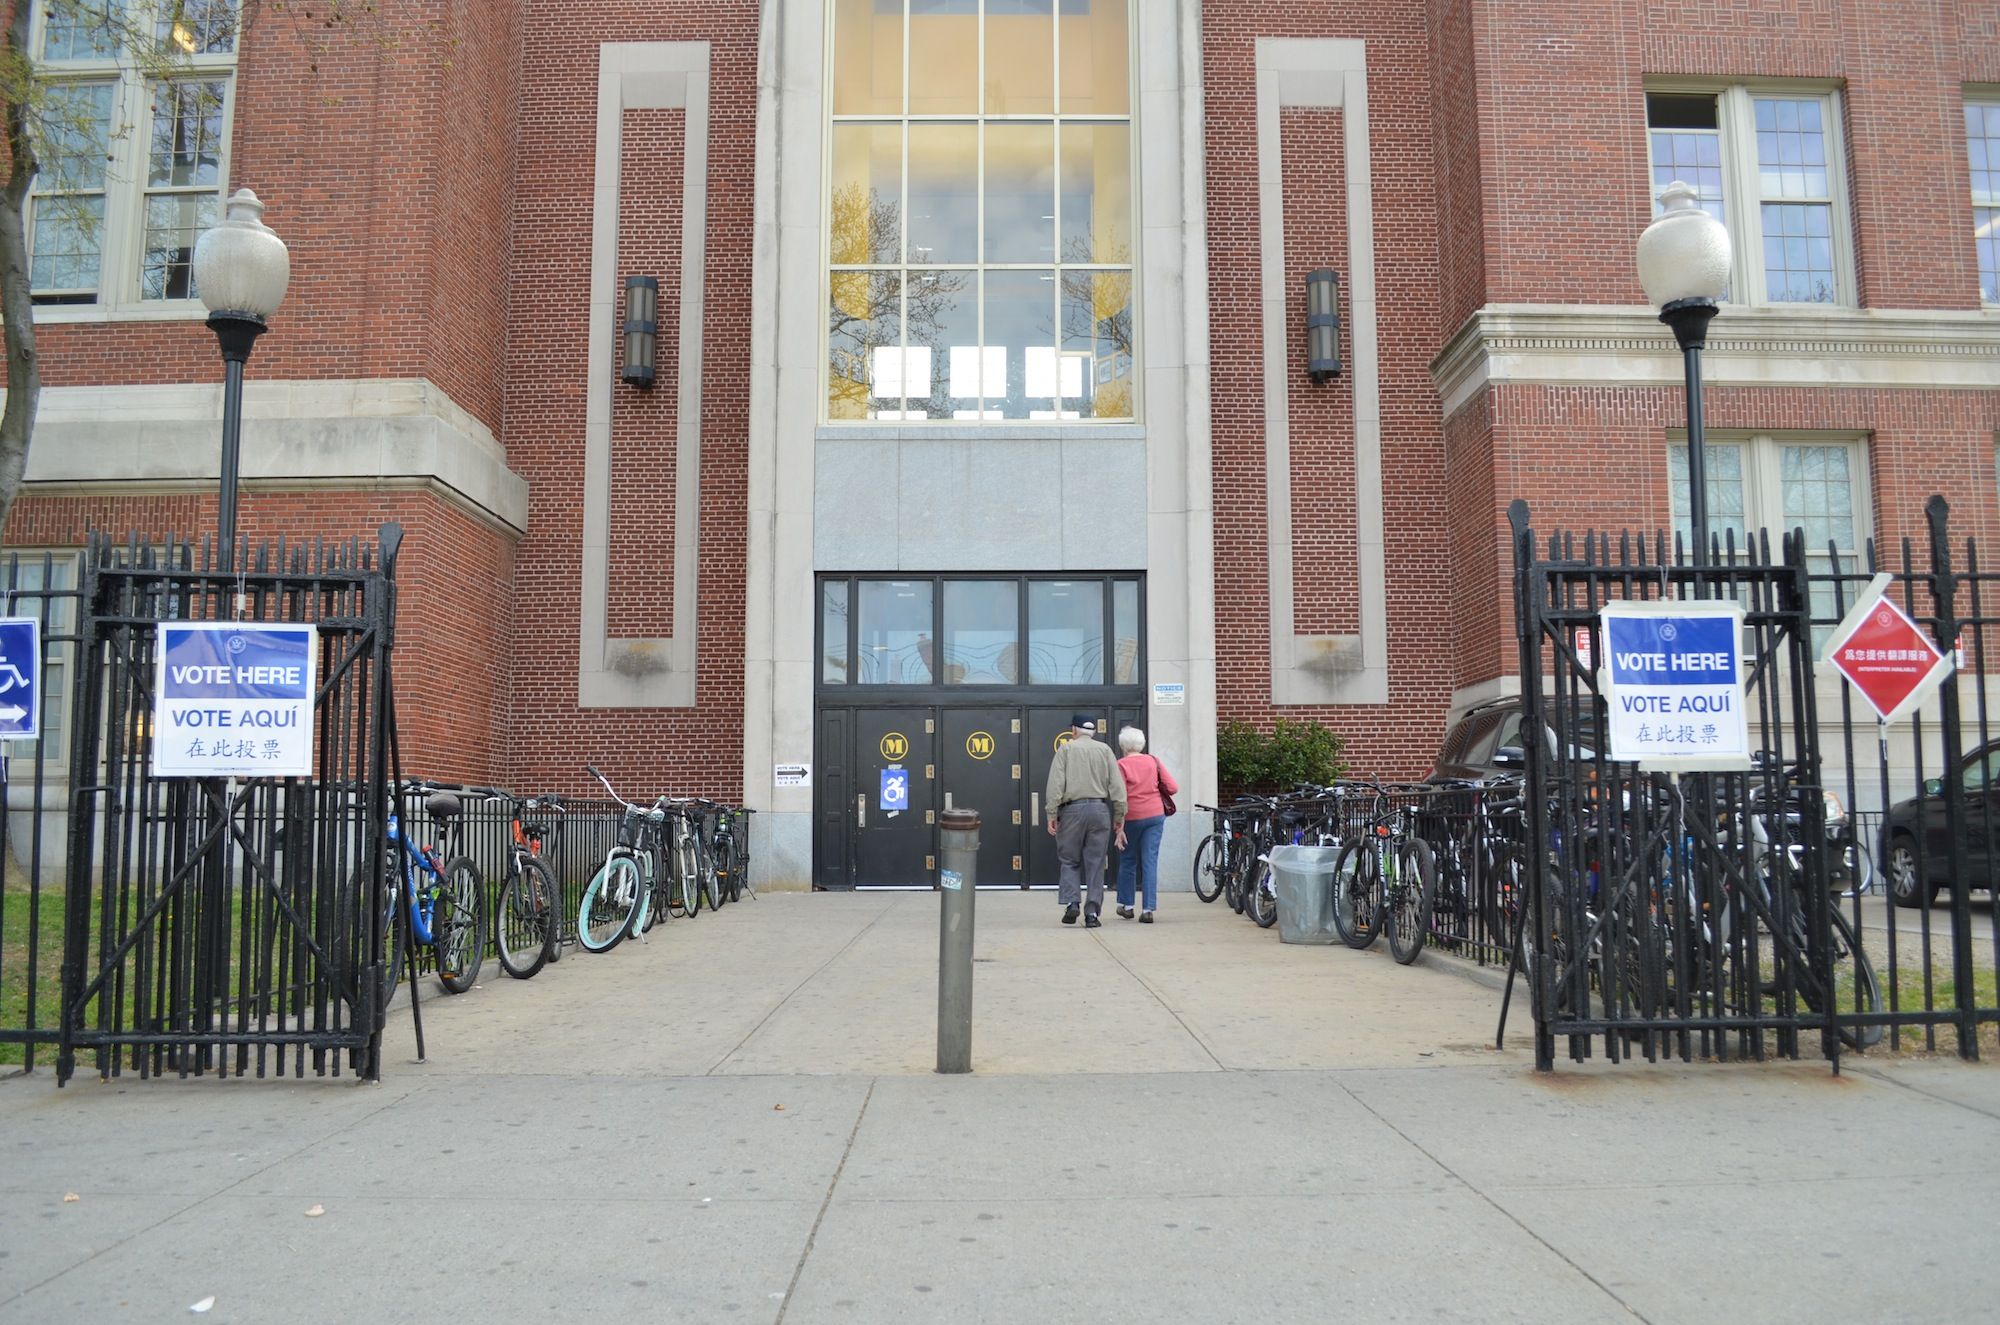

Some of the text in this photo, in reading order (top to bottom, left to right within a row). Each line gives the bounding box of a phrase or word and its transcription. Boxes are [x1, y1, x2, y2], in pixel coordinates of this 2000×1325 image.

[1616, 652, 1730, 671] VOTE HERE
[172, 665, 300, 685] VOTE HERE
[1621, 690, 1730, 713] VOTE AQUÍ
[172, 705, 298, 728] VOTE AQUÍ
[1636, 723, 1719, 744] 在此投票
[186, 738, 281, 760] 在此投票
[885, 739, 903, 754] M
[971, 738, 990, 753] M
